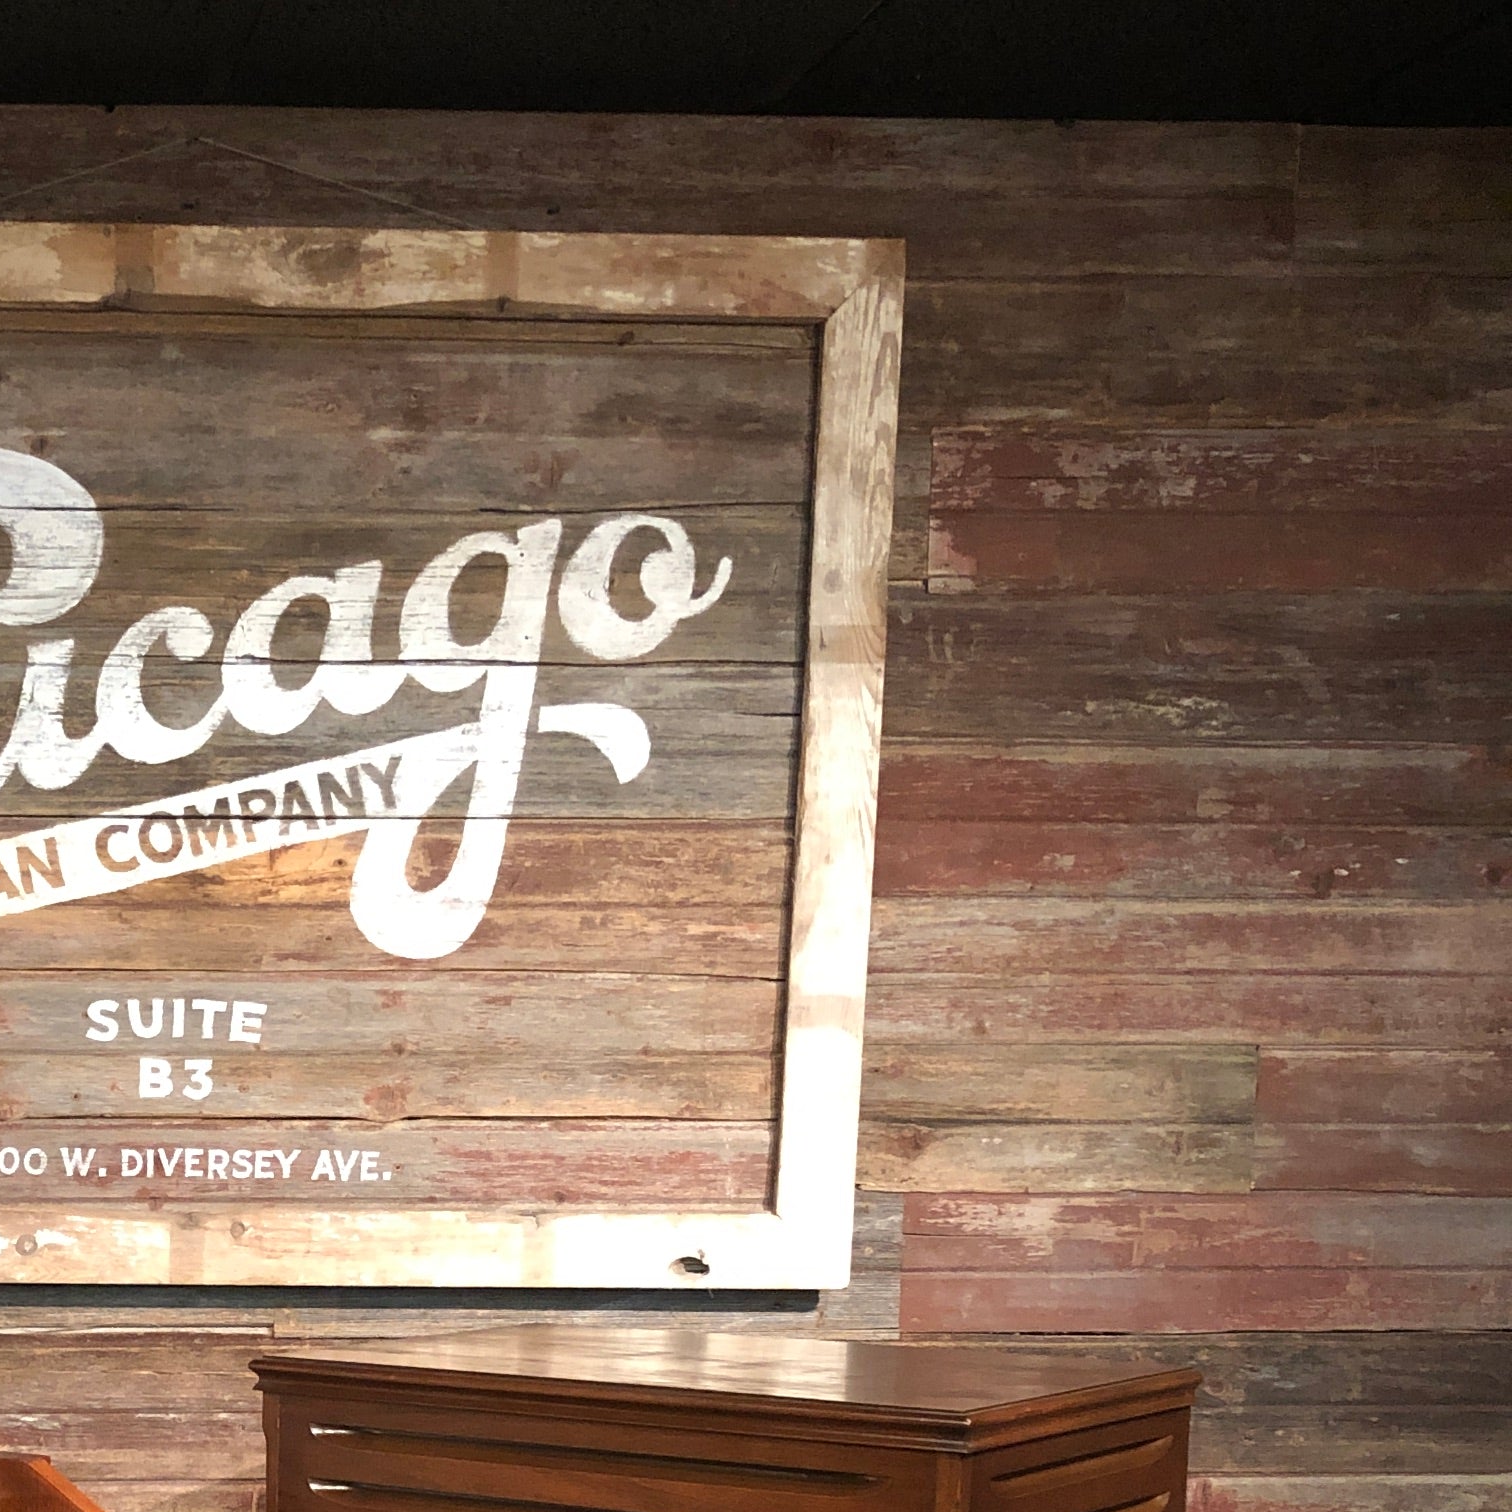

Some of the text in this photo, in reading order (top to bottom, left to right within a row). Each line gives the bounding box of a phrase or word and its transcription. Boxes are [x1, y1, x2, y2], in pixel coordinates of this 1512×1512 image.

[95, 755, 402, 874] COMPANY
[85, 998, 268, 1044] SUITE
[138, 1057, 214, 1100] B3
[59, 1147, 108, 1178] W.
[120, 1148, 302, 1180] DIVERSEY
[310, 1149, 393, 1182] AVE.
